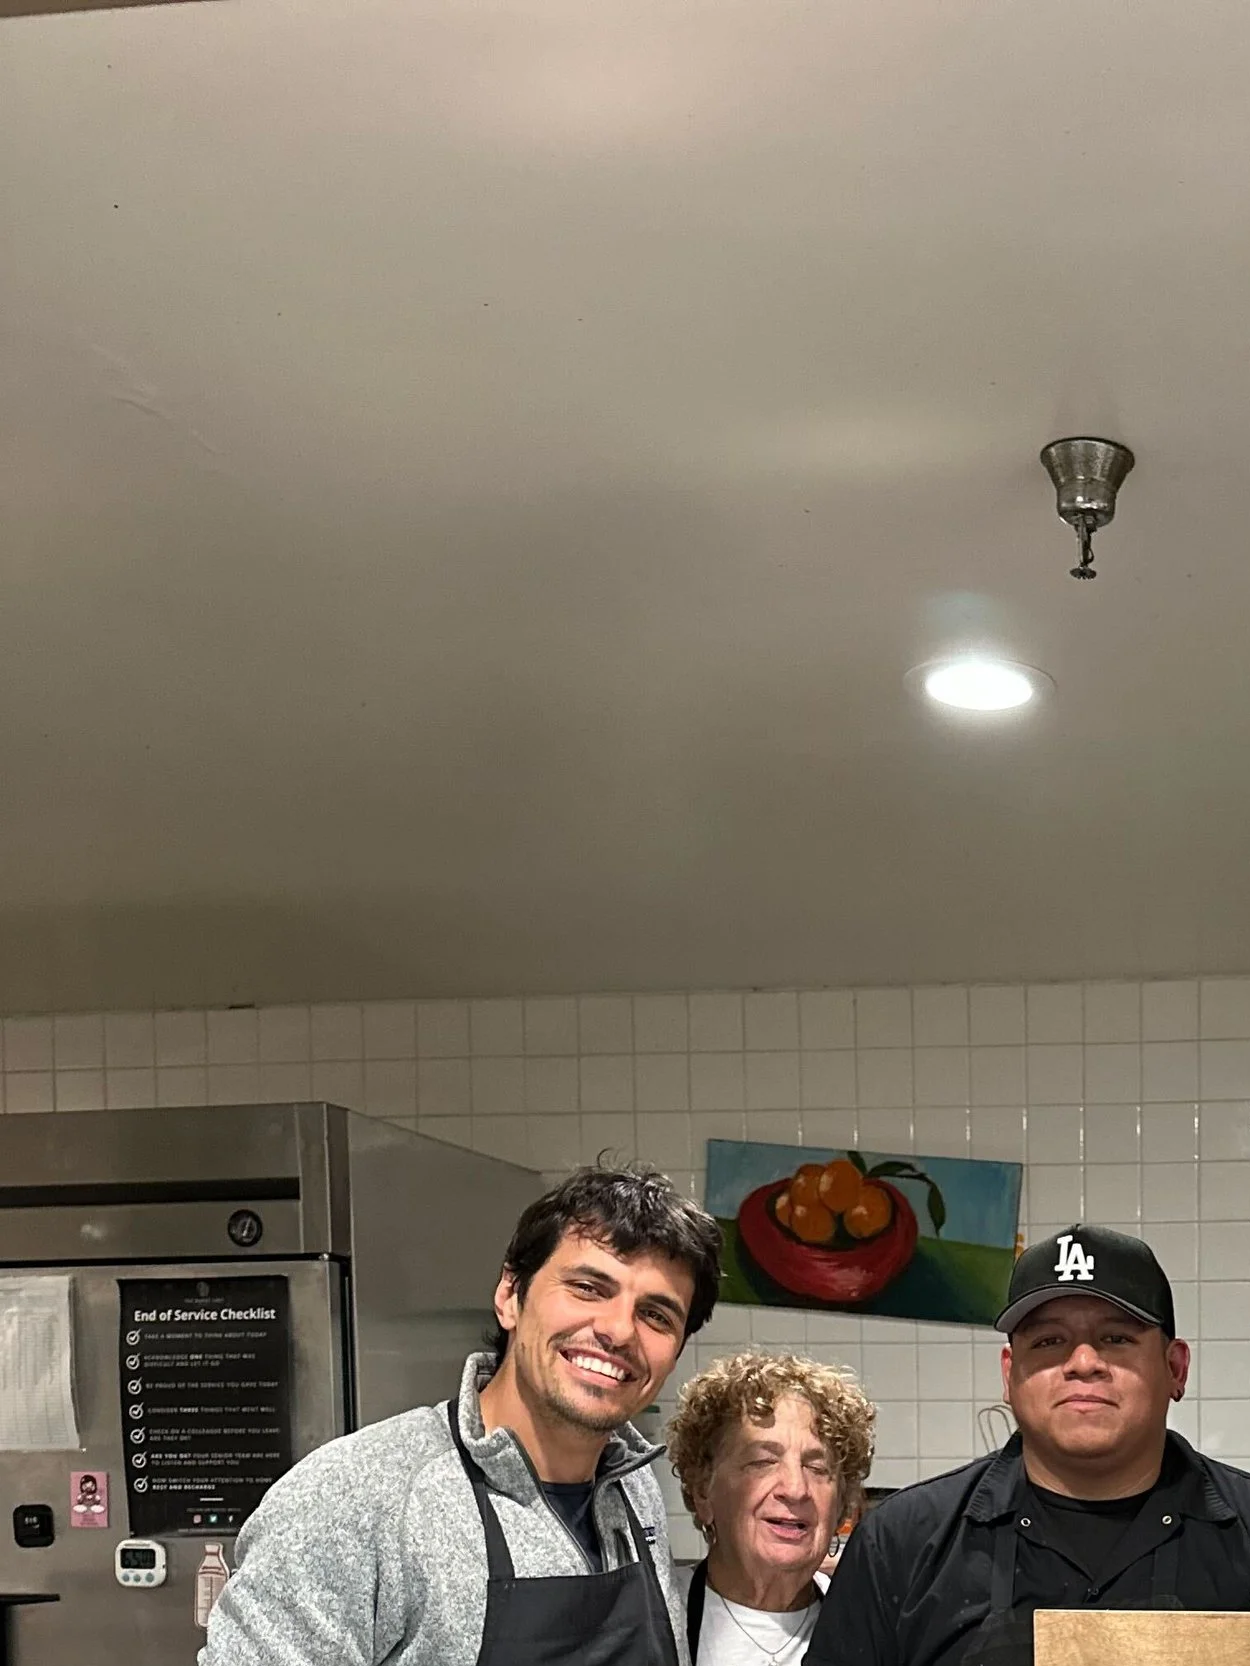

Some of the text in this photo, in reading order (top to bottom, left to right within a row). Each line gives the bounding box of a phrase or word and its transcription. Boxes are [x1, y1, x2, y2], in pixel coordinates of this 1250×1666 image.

[1054, 1235, 1094, 1281] LA
[134, 1307, 276, 1321] End of Service Checklist
